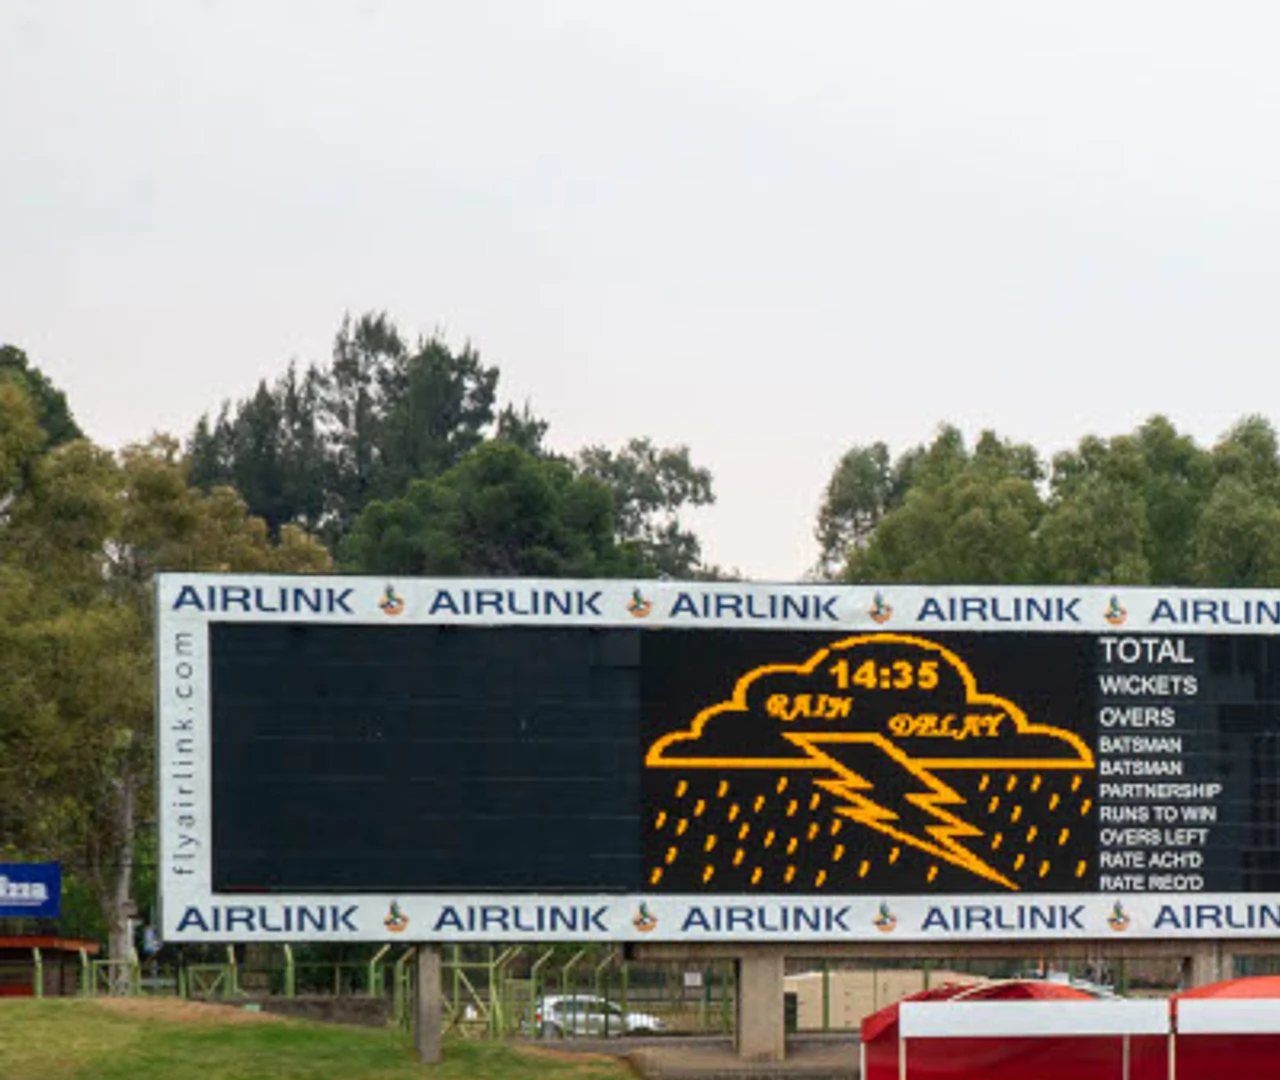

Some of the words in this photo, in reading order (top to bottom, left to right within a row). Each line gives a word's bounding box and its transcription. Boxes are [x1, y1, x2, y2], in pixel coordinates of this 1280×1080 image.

[172, 585, 354, 613] AIRLINK
[428, 589, 603, 615] AIRLINK
[669, 593, 839, 620] AIRLINK
[917, 597, 1081, 622] AIRLINK
[1100, 637, 1194, 664] TOTAL
[829, 660, 940, 690] 14:35
[1099, 675, 1198, 695] WICKETS
[765, 694, 853, 720] RAIN
[887, 712, 1006, 741] DELAY
[1099, 707, 1175, 728] OVERS
[172, 631, 200, 876] flyairlink.com
[1100, 737, 1182, 753] BATSMAN
[1100, 760, 1182, 776] BATSMAN
[1100, 783, 1223, 798] PARTNERSHIP
[1100, 805, 1149, 822] RUNS
[1153, 805, 1178, 822] TO
[1180, 805, 1217, 821] WIN
[1100, 828, 1161, 845] OVERS
[1164, 828, 1210, 845] LEFT
[1100, 851, 1146, 868] RATE
[1100, 874, 1146, 890] RATE
[177, 906, 358, 932] AIRLINK
[433, 906, 608, 932] AIRLINK
[681, 906, 851, 933] AIRLINK
[922, 905, 1086, 931] AIRLINK
